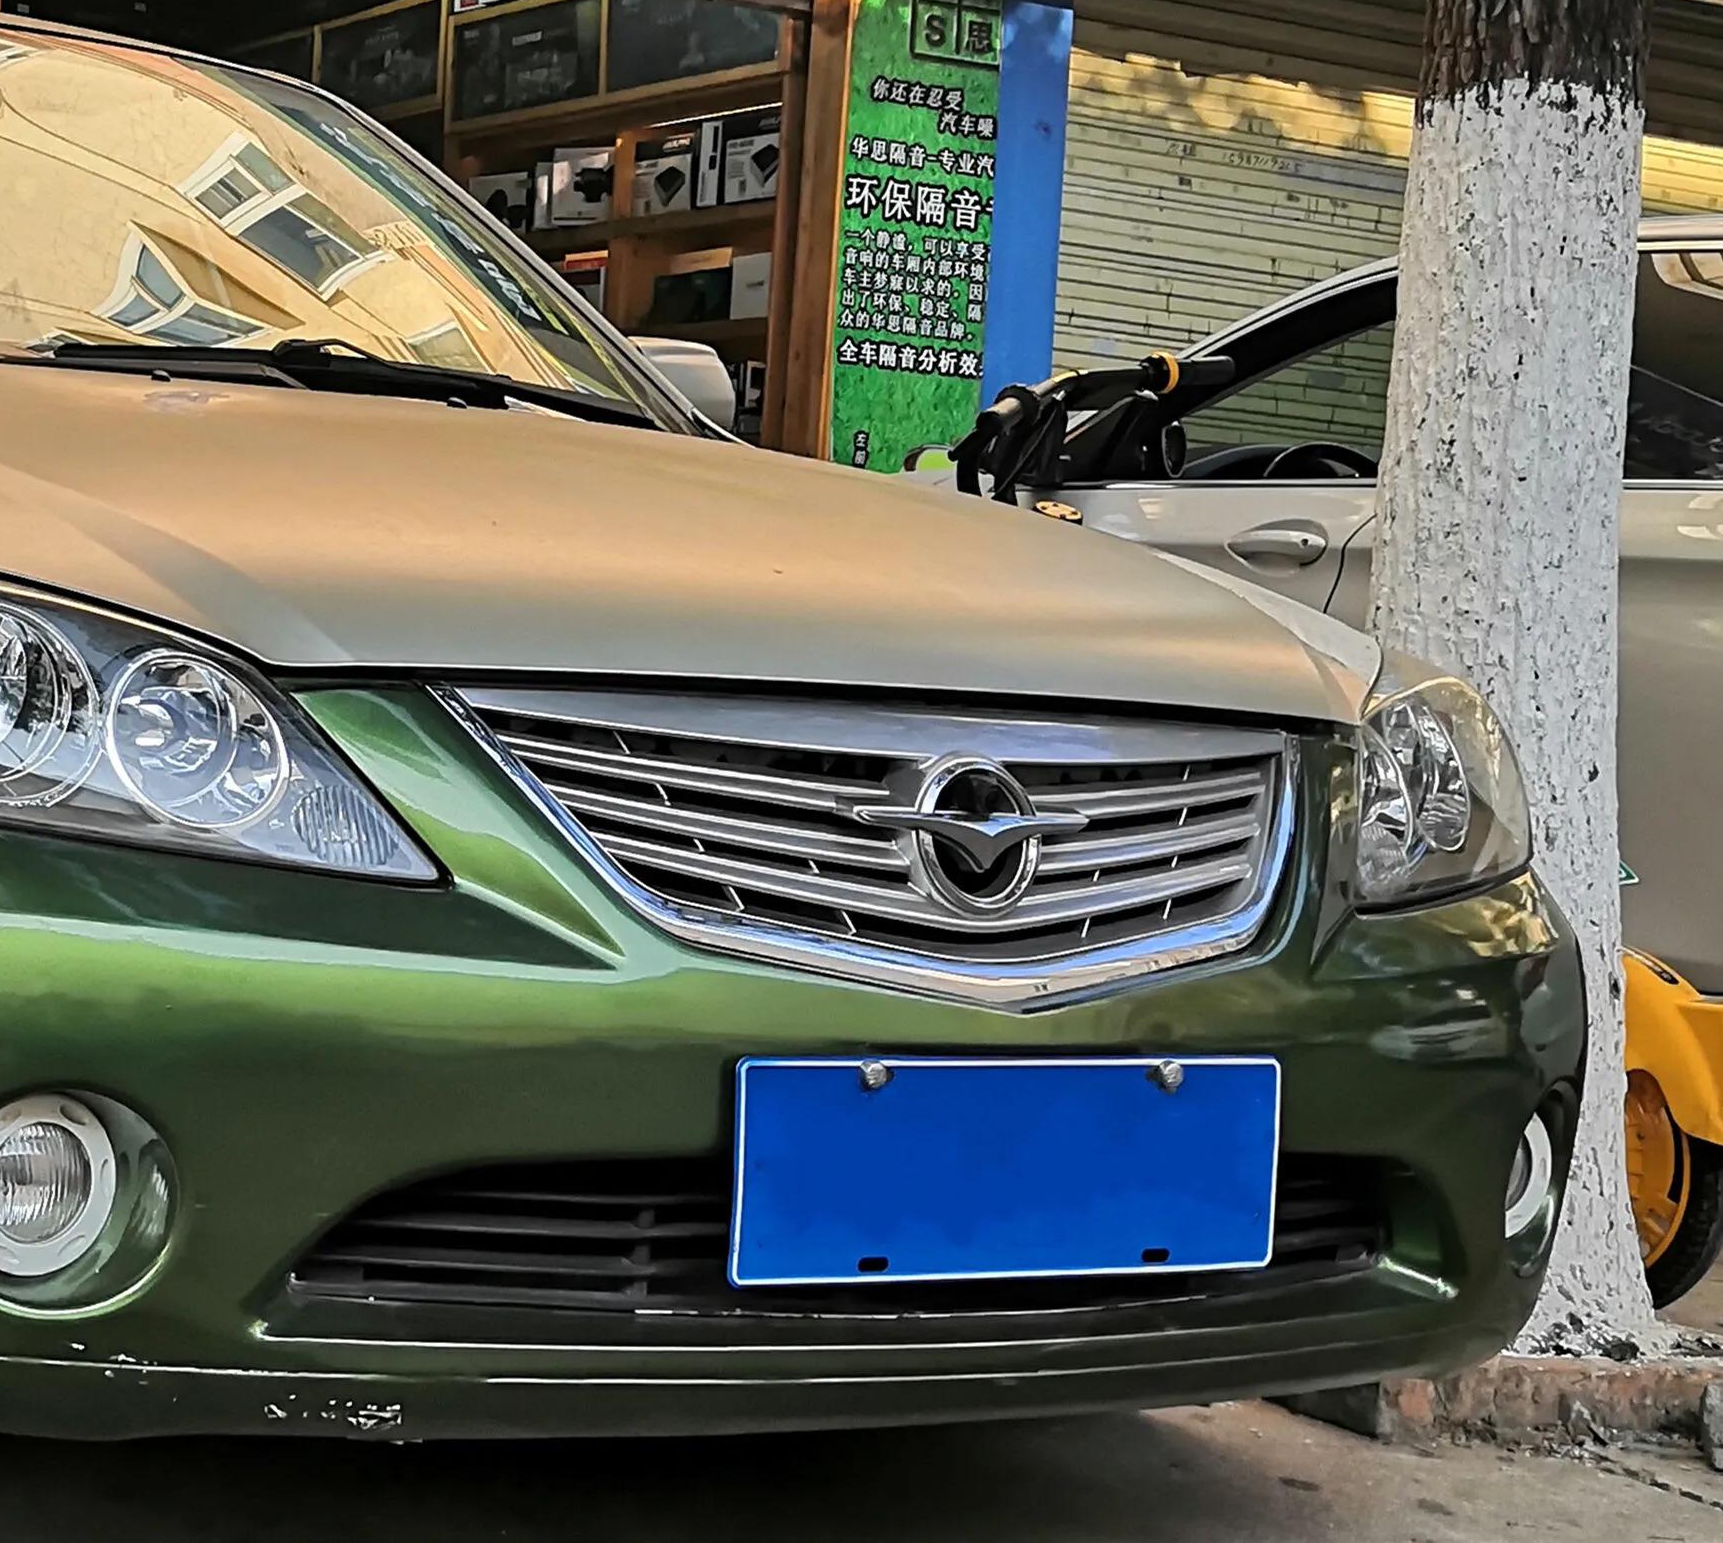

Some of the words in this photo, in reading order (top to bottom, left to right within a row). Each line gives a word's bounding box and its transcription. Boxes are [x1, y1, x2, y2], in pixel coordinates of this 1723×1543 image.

[872, 77, 963, 112] 你还在忍受
[845, 176, 995, 231] 环保隔音
[844, 247, 990, 283] 音响的车厢内部环境
[839, 339, 984, 377] 全车隔音分析效
